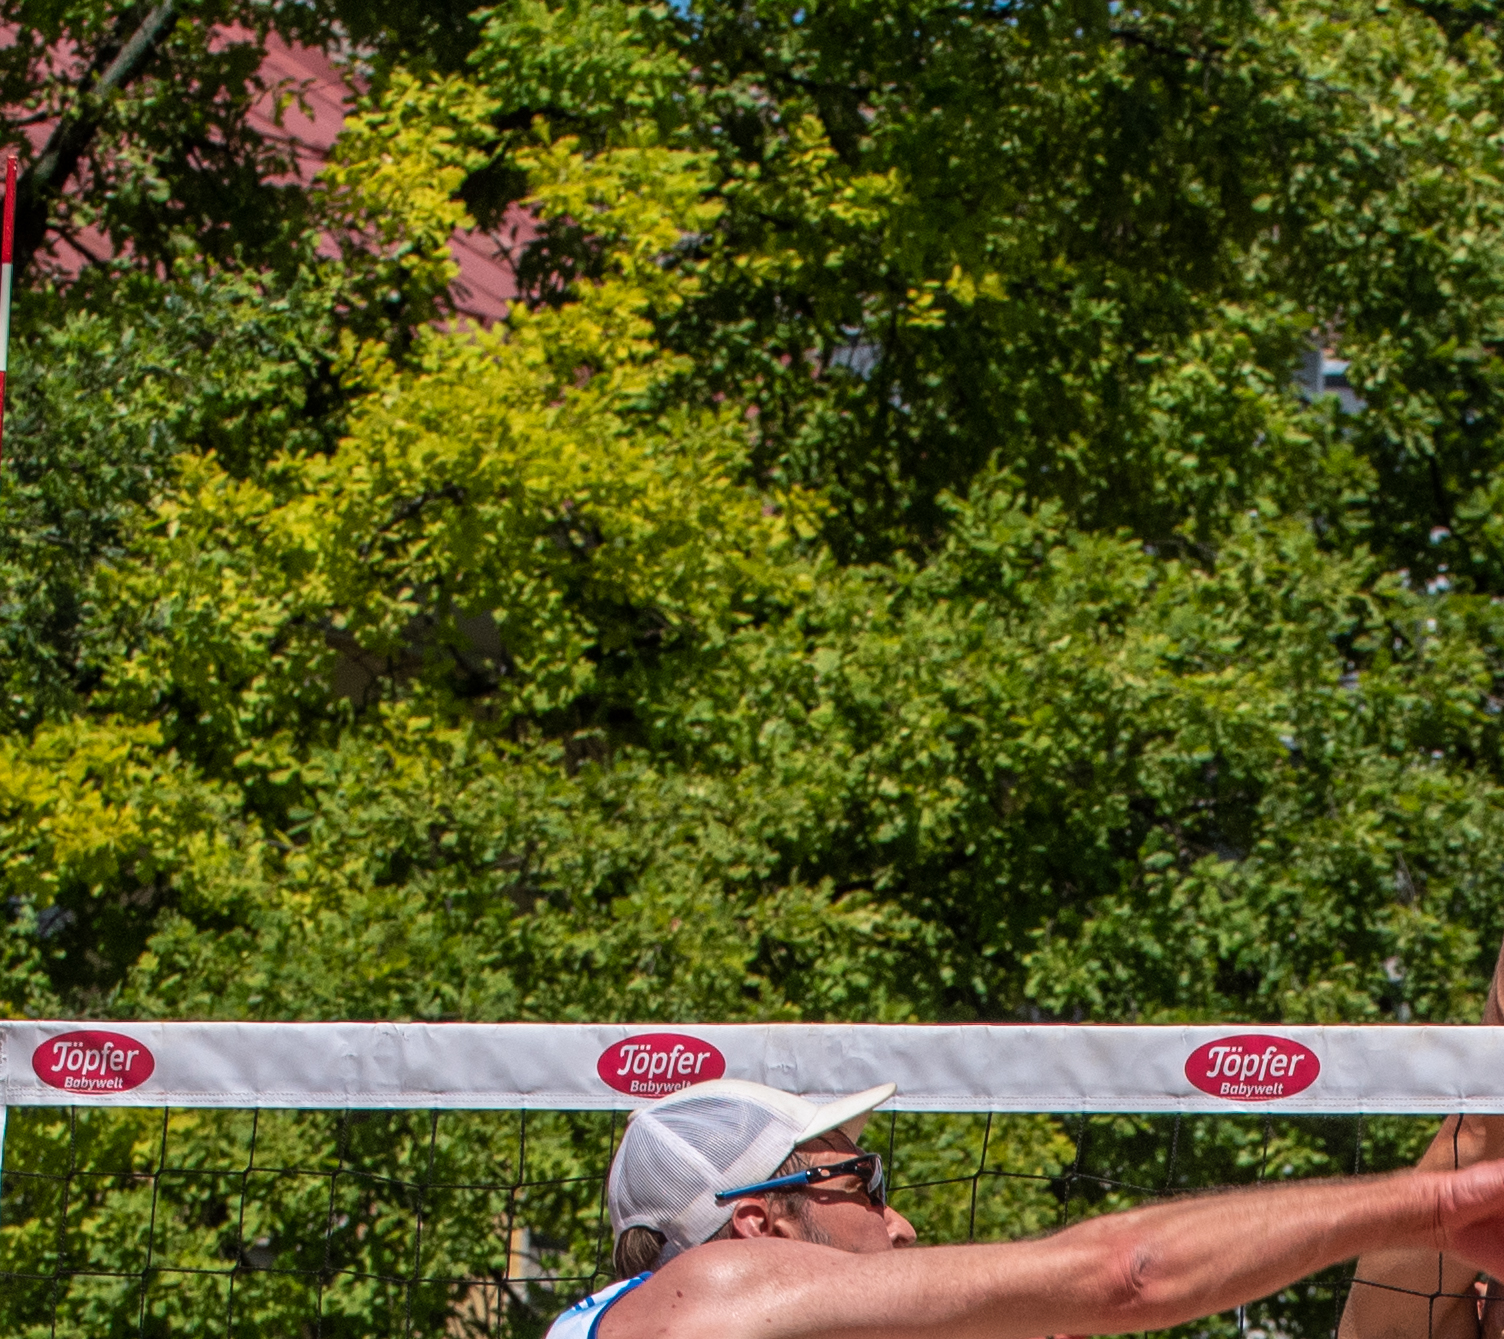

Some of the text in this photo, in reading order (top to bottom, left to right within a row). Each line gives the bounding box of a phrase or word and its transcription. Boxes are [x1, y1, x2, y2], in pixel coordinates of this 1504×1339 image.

[50, 1041, 140, 1076] Töpfer
[616, 1044, 711, 1079] Töpfer
[1206, 1045, 1305, 1082] Töpfer
[64, 1076, 123, 1091] Babywelt
[1220, 1082, 1284, 1098] Babywelt
